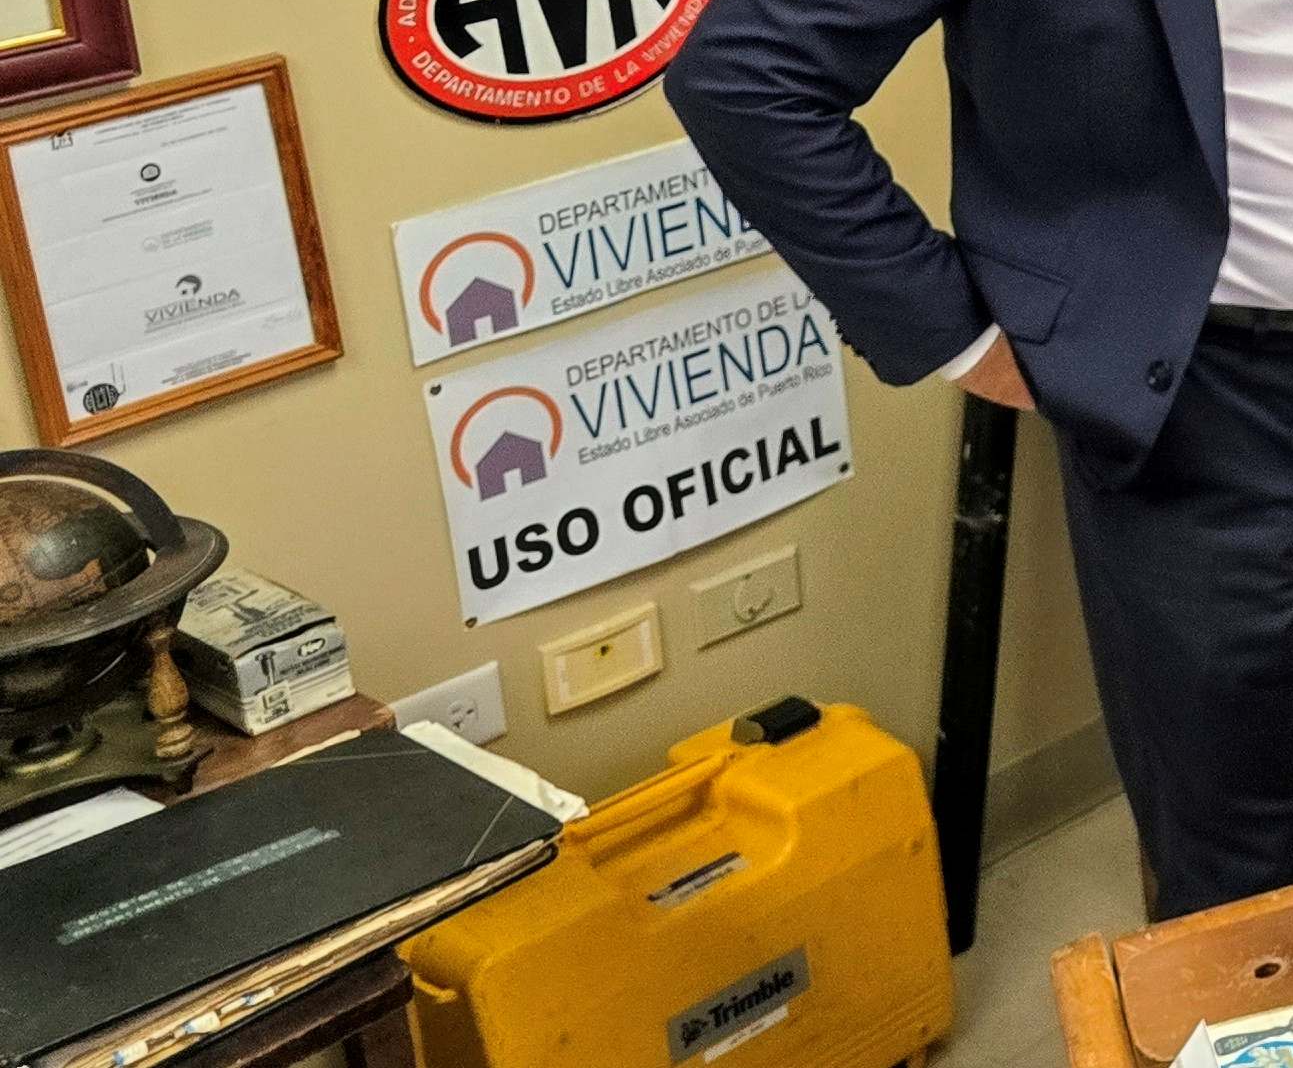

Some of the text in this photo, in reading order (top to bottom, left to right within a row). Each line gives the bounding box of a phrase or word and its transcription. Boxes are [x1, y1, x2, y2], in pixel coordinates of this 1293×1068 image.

[412, 50, 571, 108] DEPARTAMENTO
[578, 74, 606, 99] DE
[613, 59, 641, 84] LA
[537, 167, 711, 236] DEPARTAMENT
[542, 195, 754, 290] VIVIEN
[144, 288, 241, 323] VIVIENDA
[551, 236, 769, 316] Estado Libre Asociado de Puer
[566, 307, 752, 387] DEPARTAMENTO
[758, 295, 789, 323] DE
[570, 313, 830, 439] VIVIENDA
[578, 364, 833, 465] Estado Libre Asociado de Puerto Rico
[467, 416, 841, 592] USO OFICIAL
[707, 970, 795, 1029] Trimble
